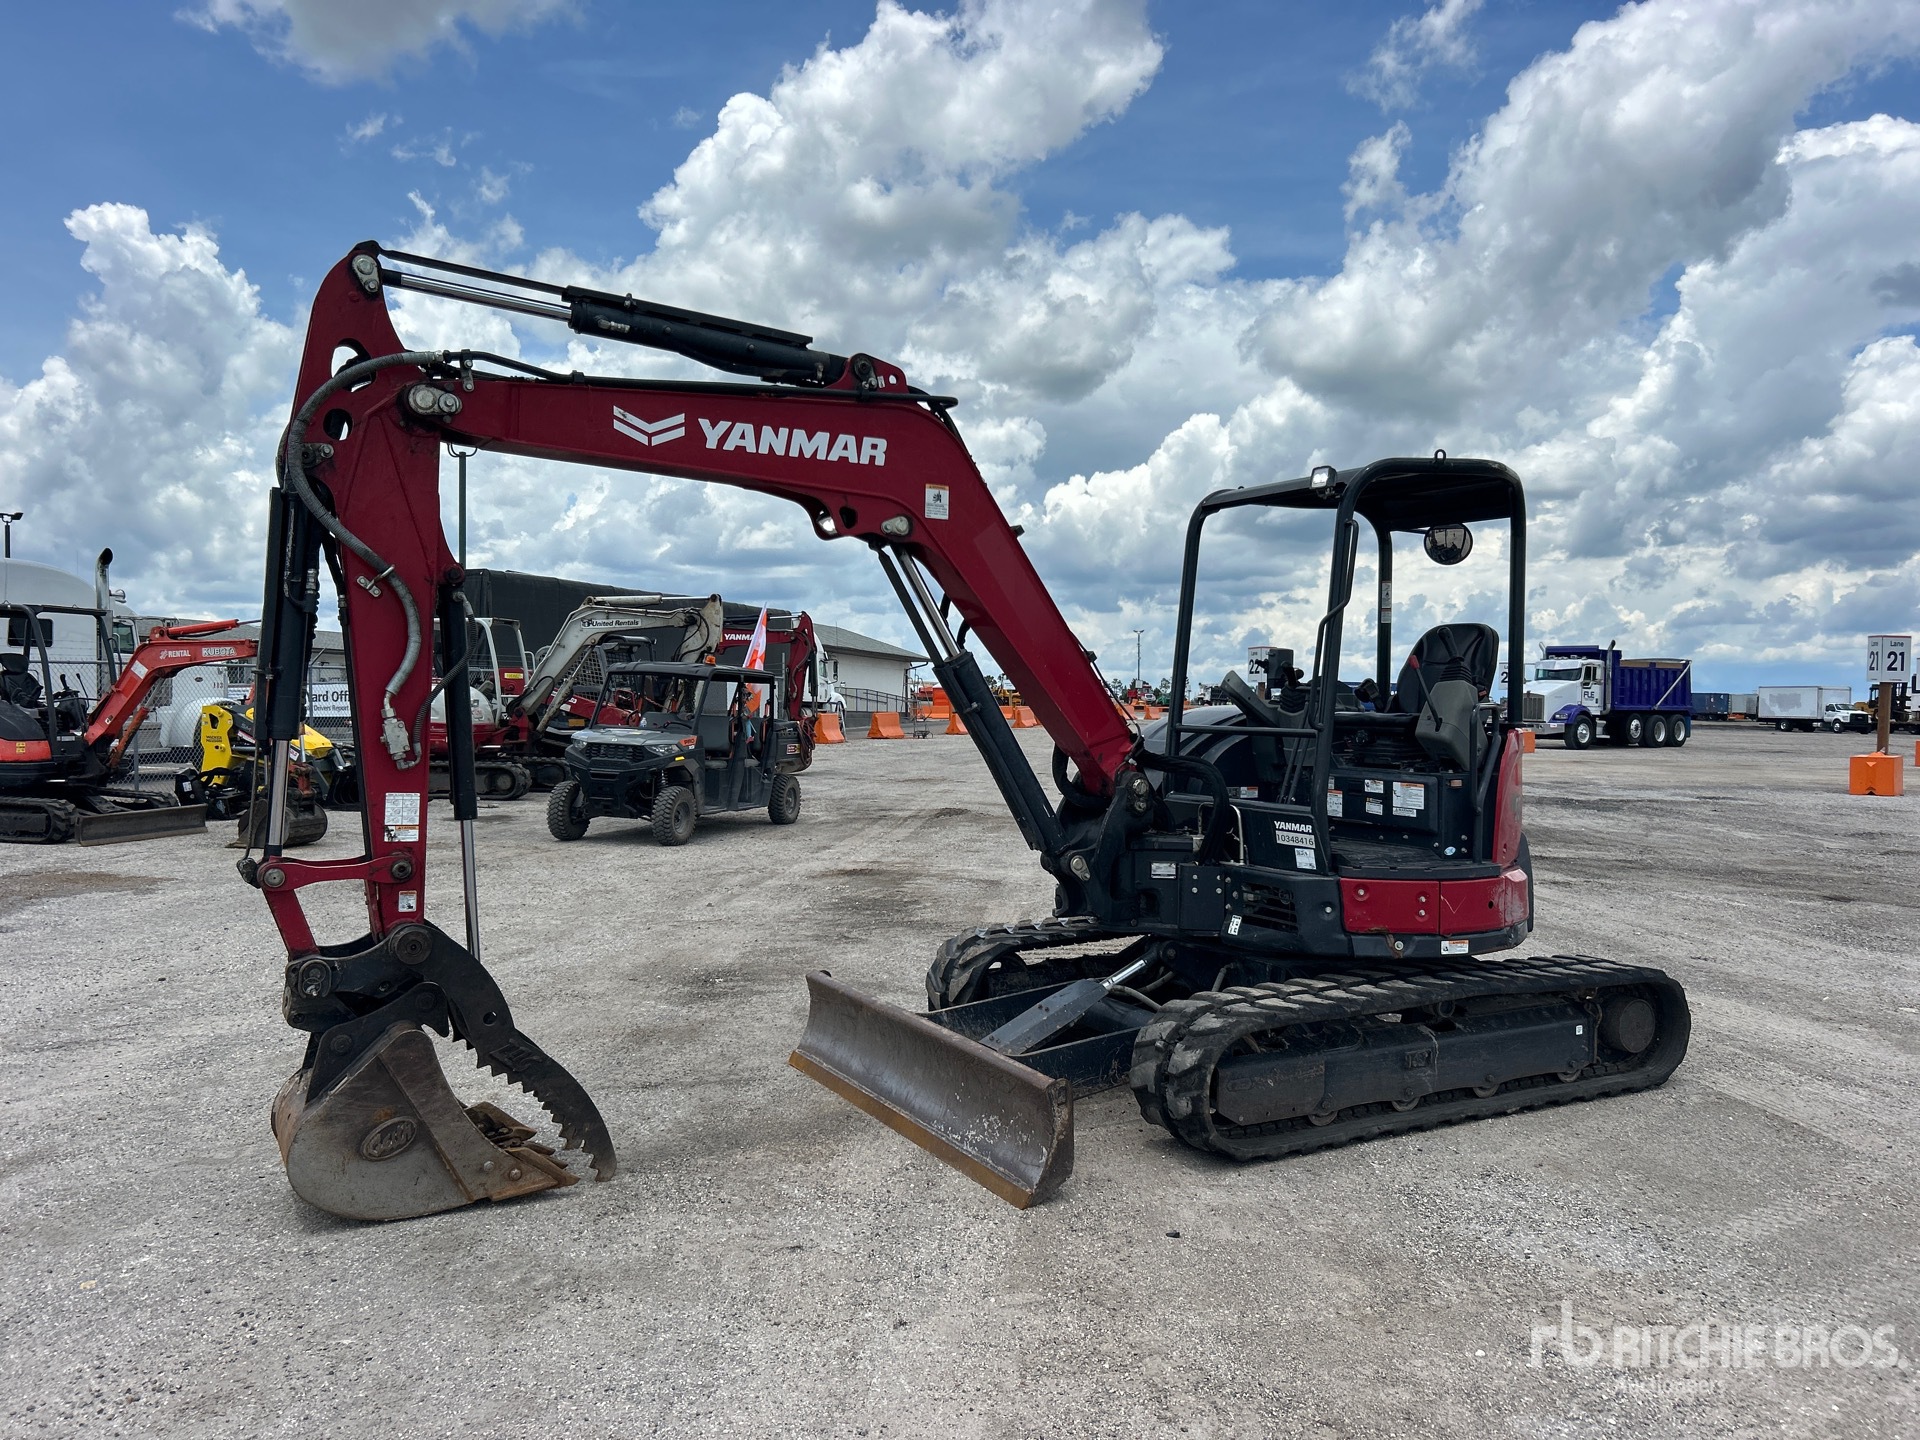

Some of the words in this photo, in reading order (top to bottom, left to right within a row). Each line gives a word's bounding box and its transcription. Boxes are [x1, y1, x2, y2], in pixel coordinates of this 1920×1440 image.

[698, 418, 887, 467] YANMAR
[591, 619, 614, 627] United
[724, 633, 755, 641] YANMA
[168, 650, 191, 658] RENTAL
[202, 647, 236, 657] KUBOTA
[1869, 651, 1879, 671] 21
[1886, 651, 1905, 672] 21
[307, 691, 329, 702] ard
[332, 691, 350, 702] Off
[1274, 821, 1312, 833] YANMAR
[1276, 834, 1314, 846] 10348416
